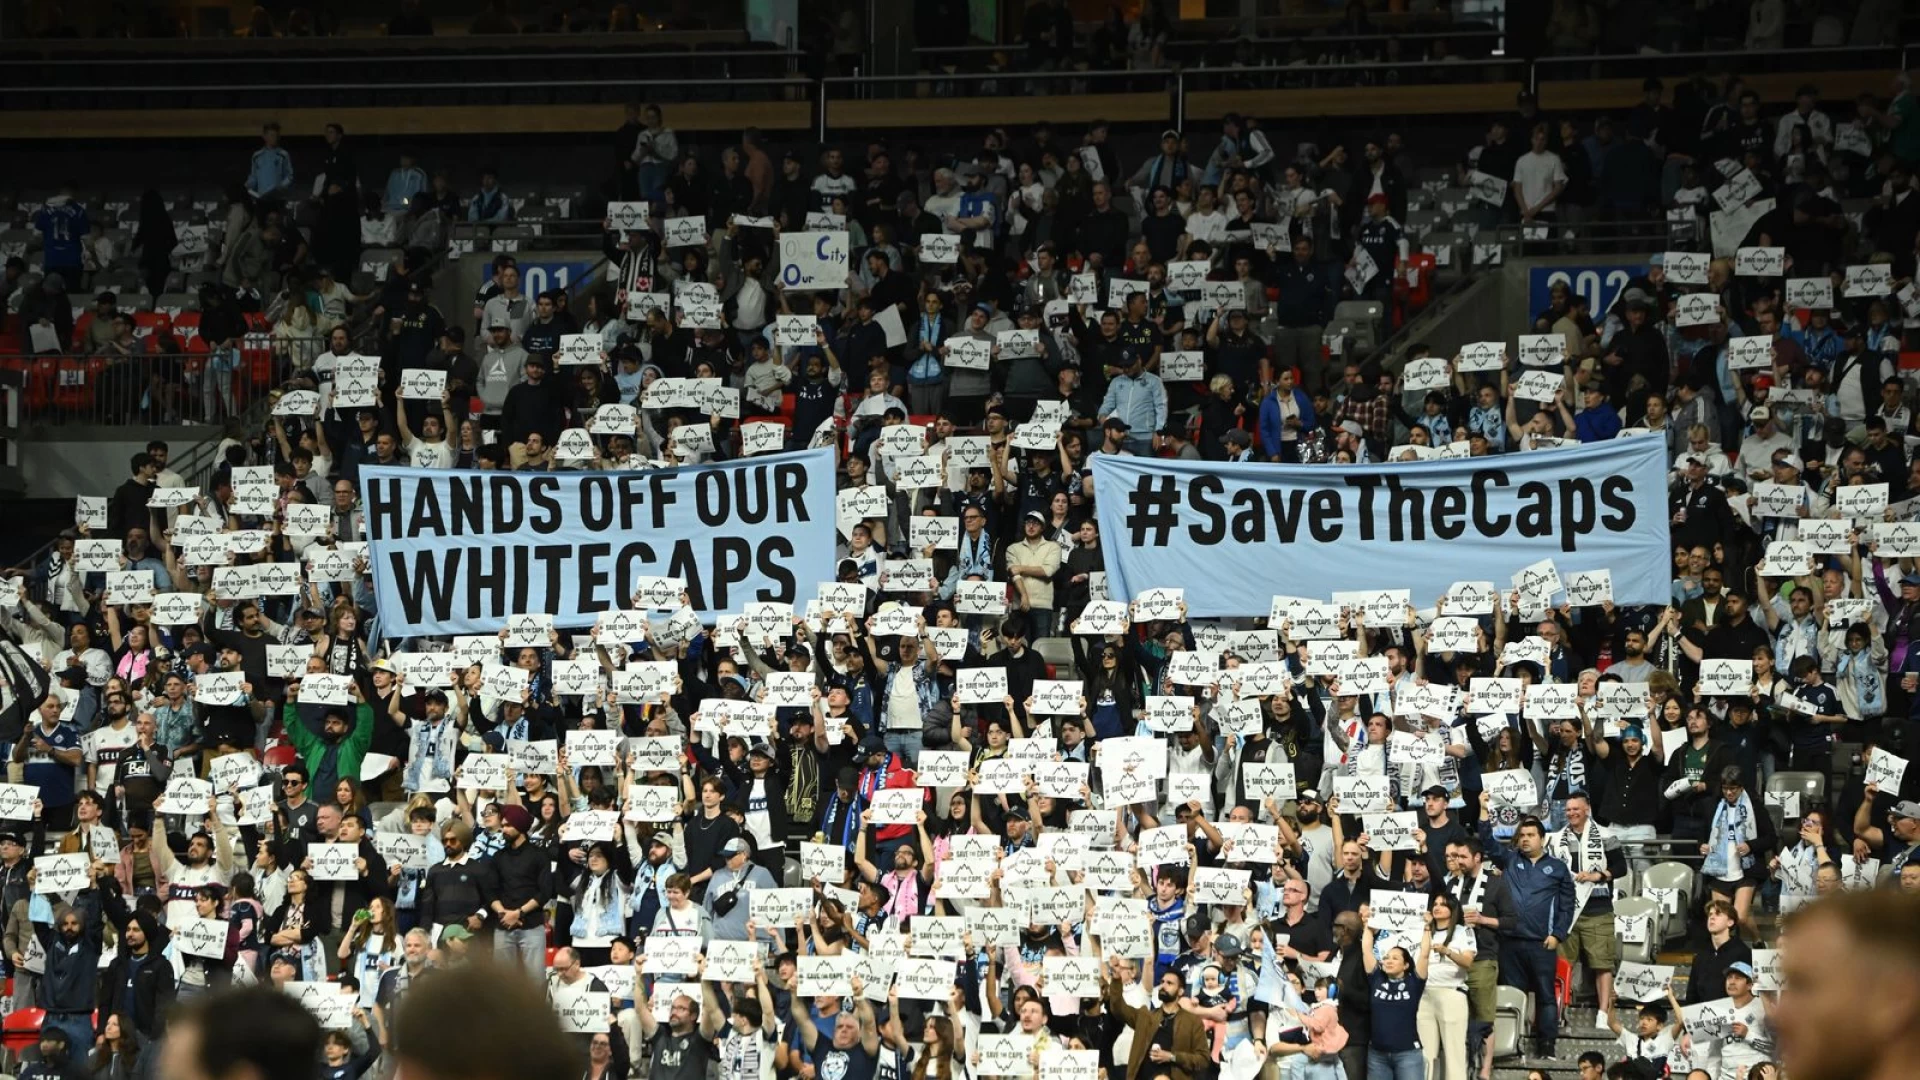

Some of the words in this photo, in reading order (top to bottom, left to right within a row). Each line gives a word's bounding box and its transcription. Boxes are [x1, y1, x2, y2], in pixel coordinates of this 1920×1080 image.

[816, 236, 847, 265] City
[525, 267, 568, 299] 01
[784, 263, 814, 286] Our
[1547, 271, 1631, 321] 02
[367, 476, 562, 540] HANDS
[580, 473, 678, 531] OFF
[695, 463, 810, 527] OUR
[1127, 470, 1636, 552] #SaveTheCaps
[390, 536, 796, 625] WHITECAPS
[1132, 781, 1145, 789] CAPS
[1402, 908, 1416, 916] CAPS
